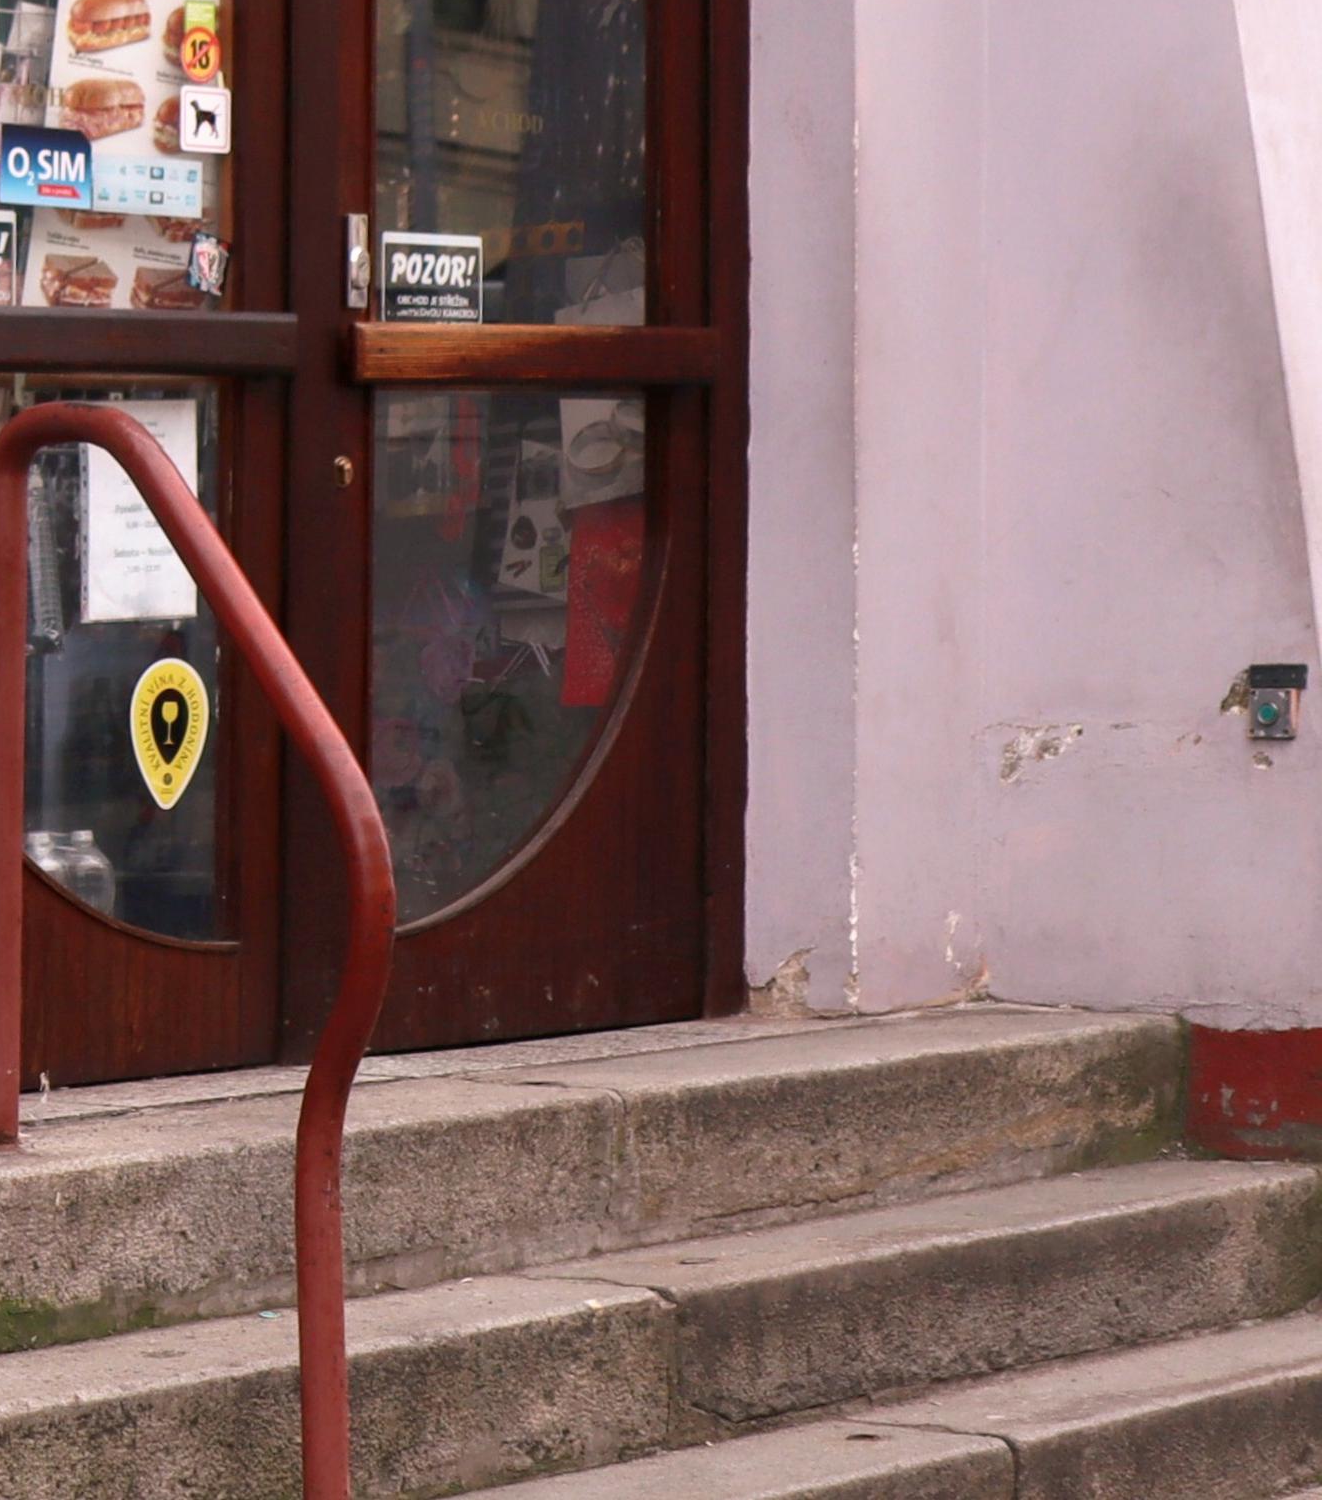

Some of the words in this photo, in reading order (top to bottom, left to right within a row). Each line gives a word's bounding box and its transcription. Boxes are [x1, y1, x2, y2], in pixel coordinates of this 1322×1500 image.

[189, 39, 211, 70] 18
[37, 149, 86, 183] SIM
[391, 252, 476, 288] POZOR!
